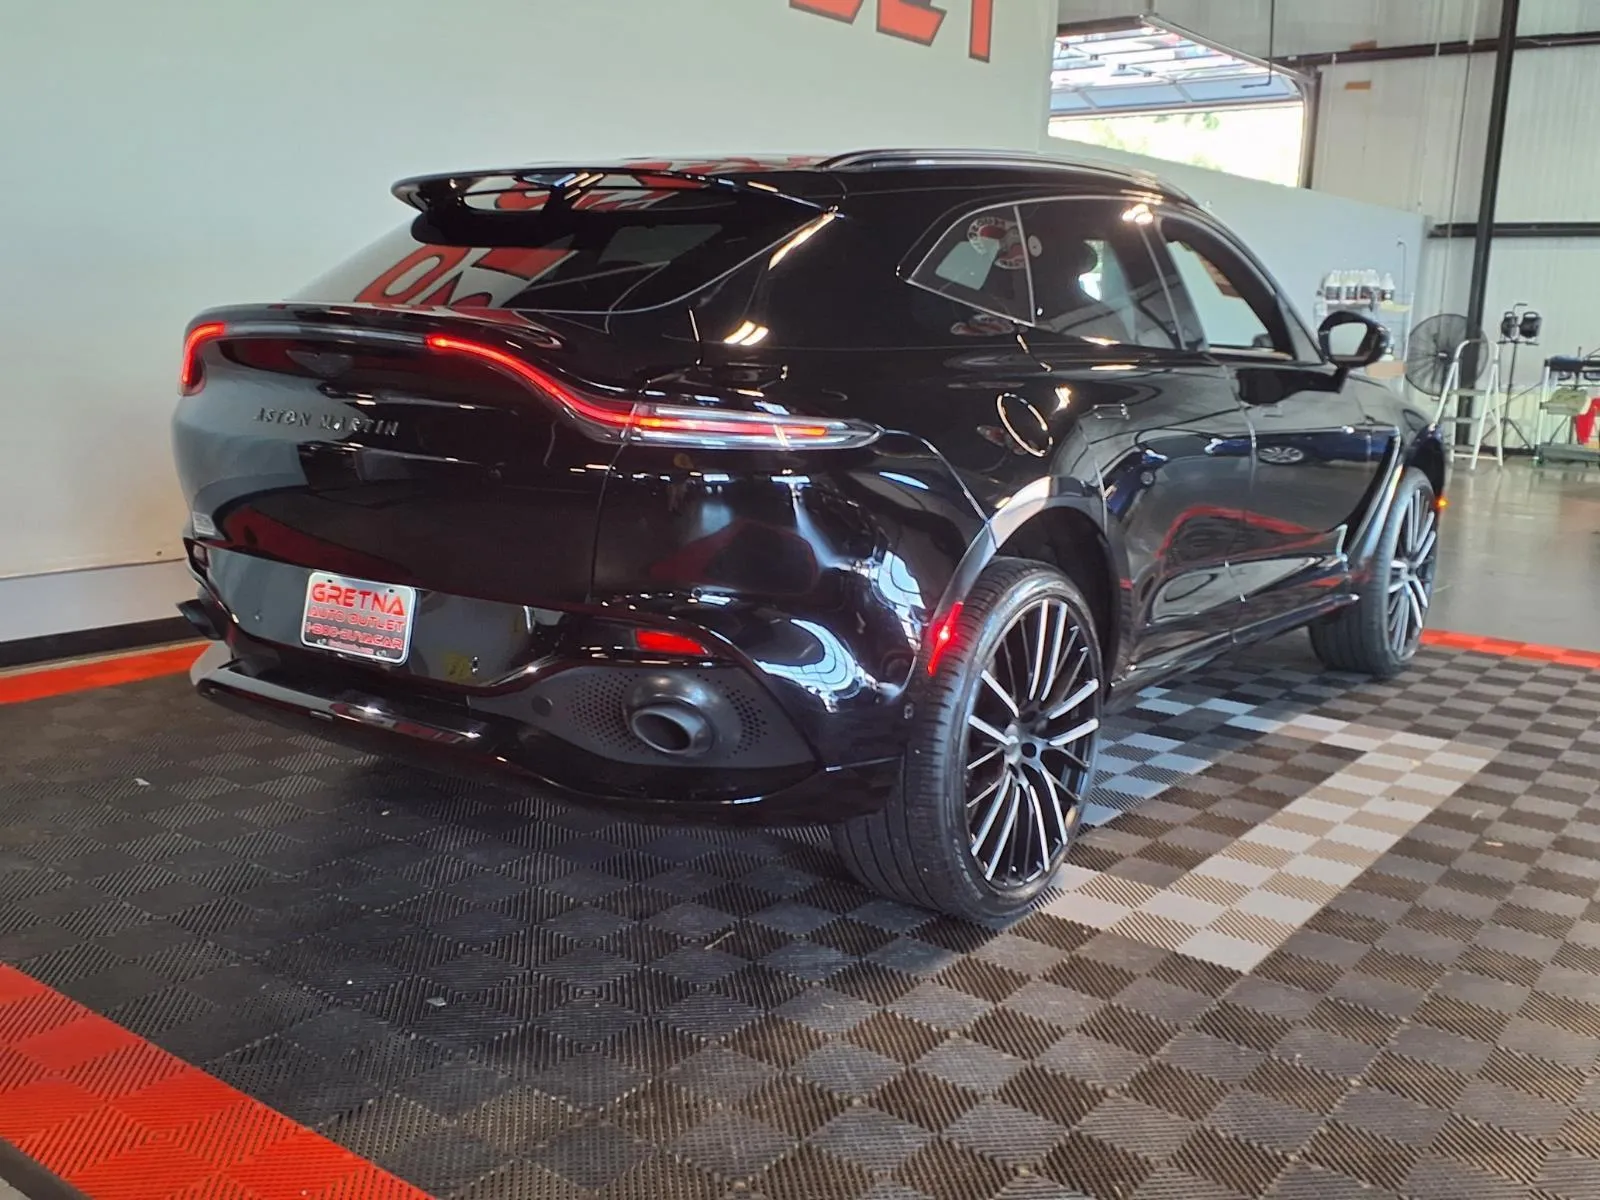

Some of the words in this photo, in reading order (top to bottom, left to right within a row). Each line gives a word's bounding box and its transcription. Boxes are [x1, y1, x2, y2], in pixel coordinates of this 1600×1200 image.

[253, 407, 312, 427] ASTON
[320, 414, 399, 437] MARTIN
[311, 583, 405, 616] GRETNA
[308, 606, 345, 623] AUTO
[346, 612, 405, 633] OUTLET
